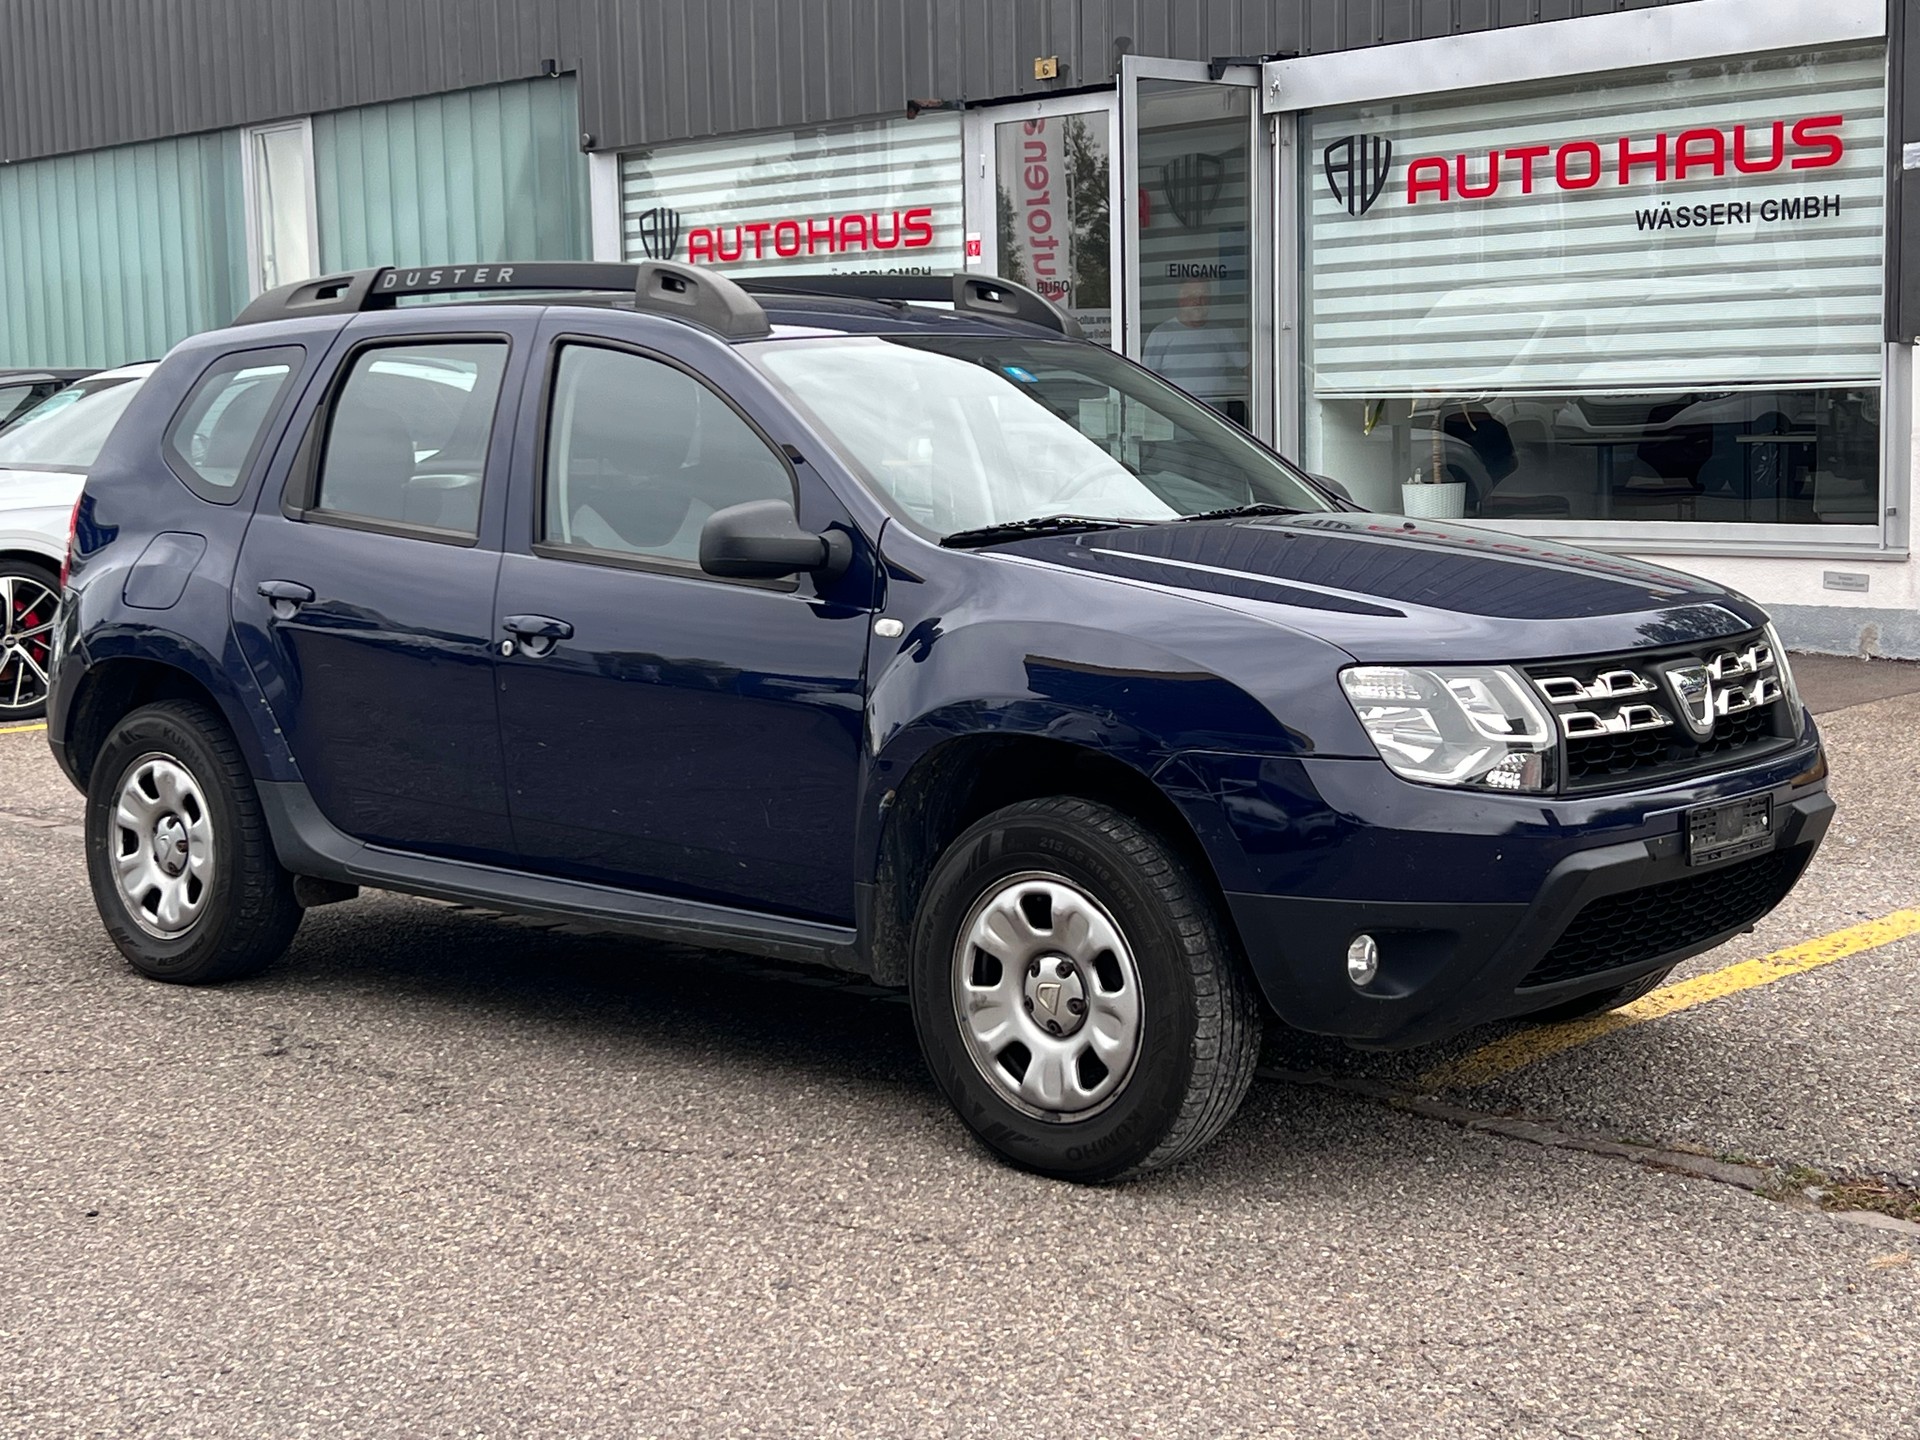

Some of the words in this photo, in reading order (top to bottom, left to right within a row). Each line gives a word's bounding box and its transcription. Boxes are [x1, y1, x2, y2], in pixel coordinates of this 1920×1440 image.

[1042, 63, 1049, 76] 6
[1407, 115, 1843, 204] AUTOHAUS
[1635, 201, 1752, 231] WÄSSERI
[1760, 194, 1841, 222] GMBH
[688, 208, 933, 264] AUTOHAUS
[383, 267, 514, 288] DUSTER
[1168, 263, 1227, 279] EINGANG
[1036, 276, 1070, 294] BÜRO
